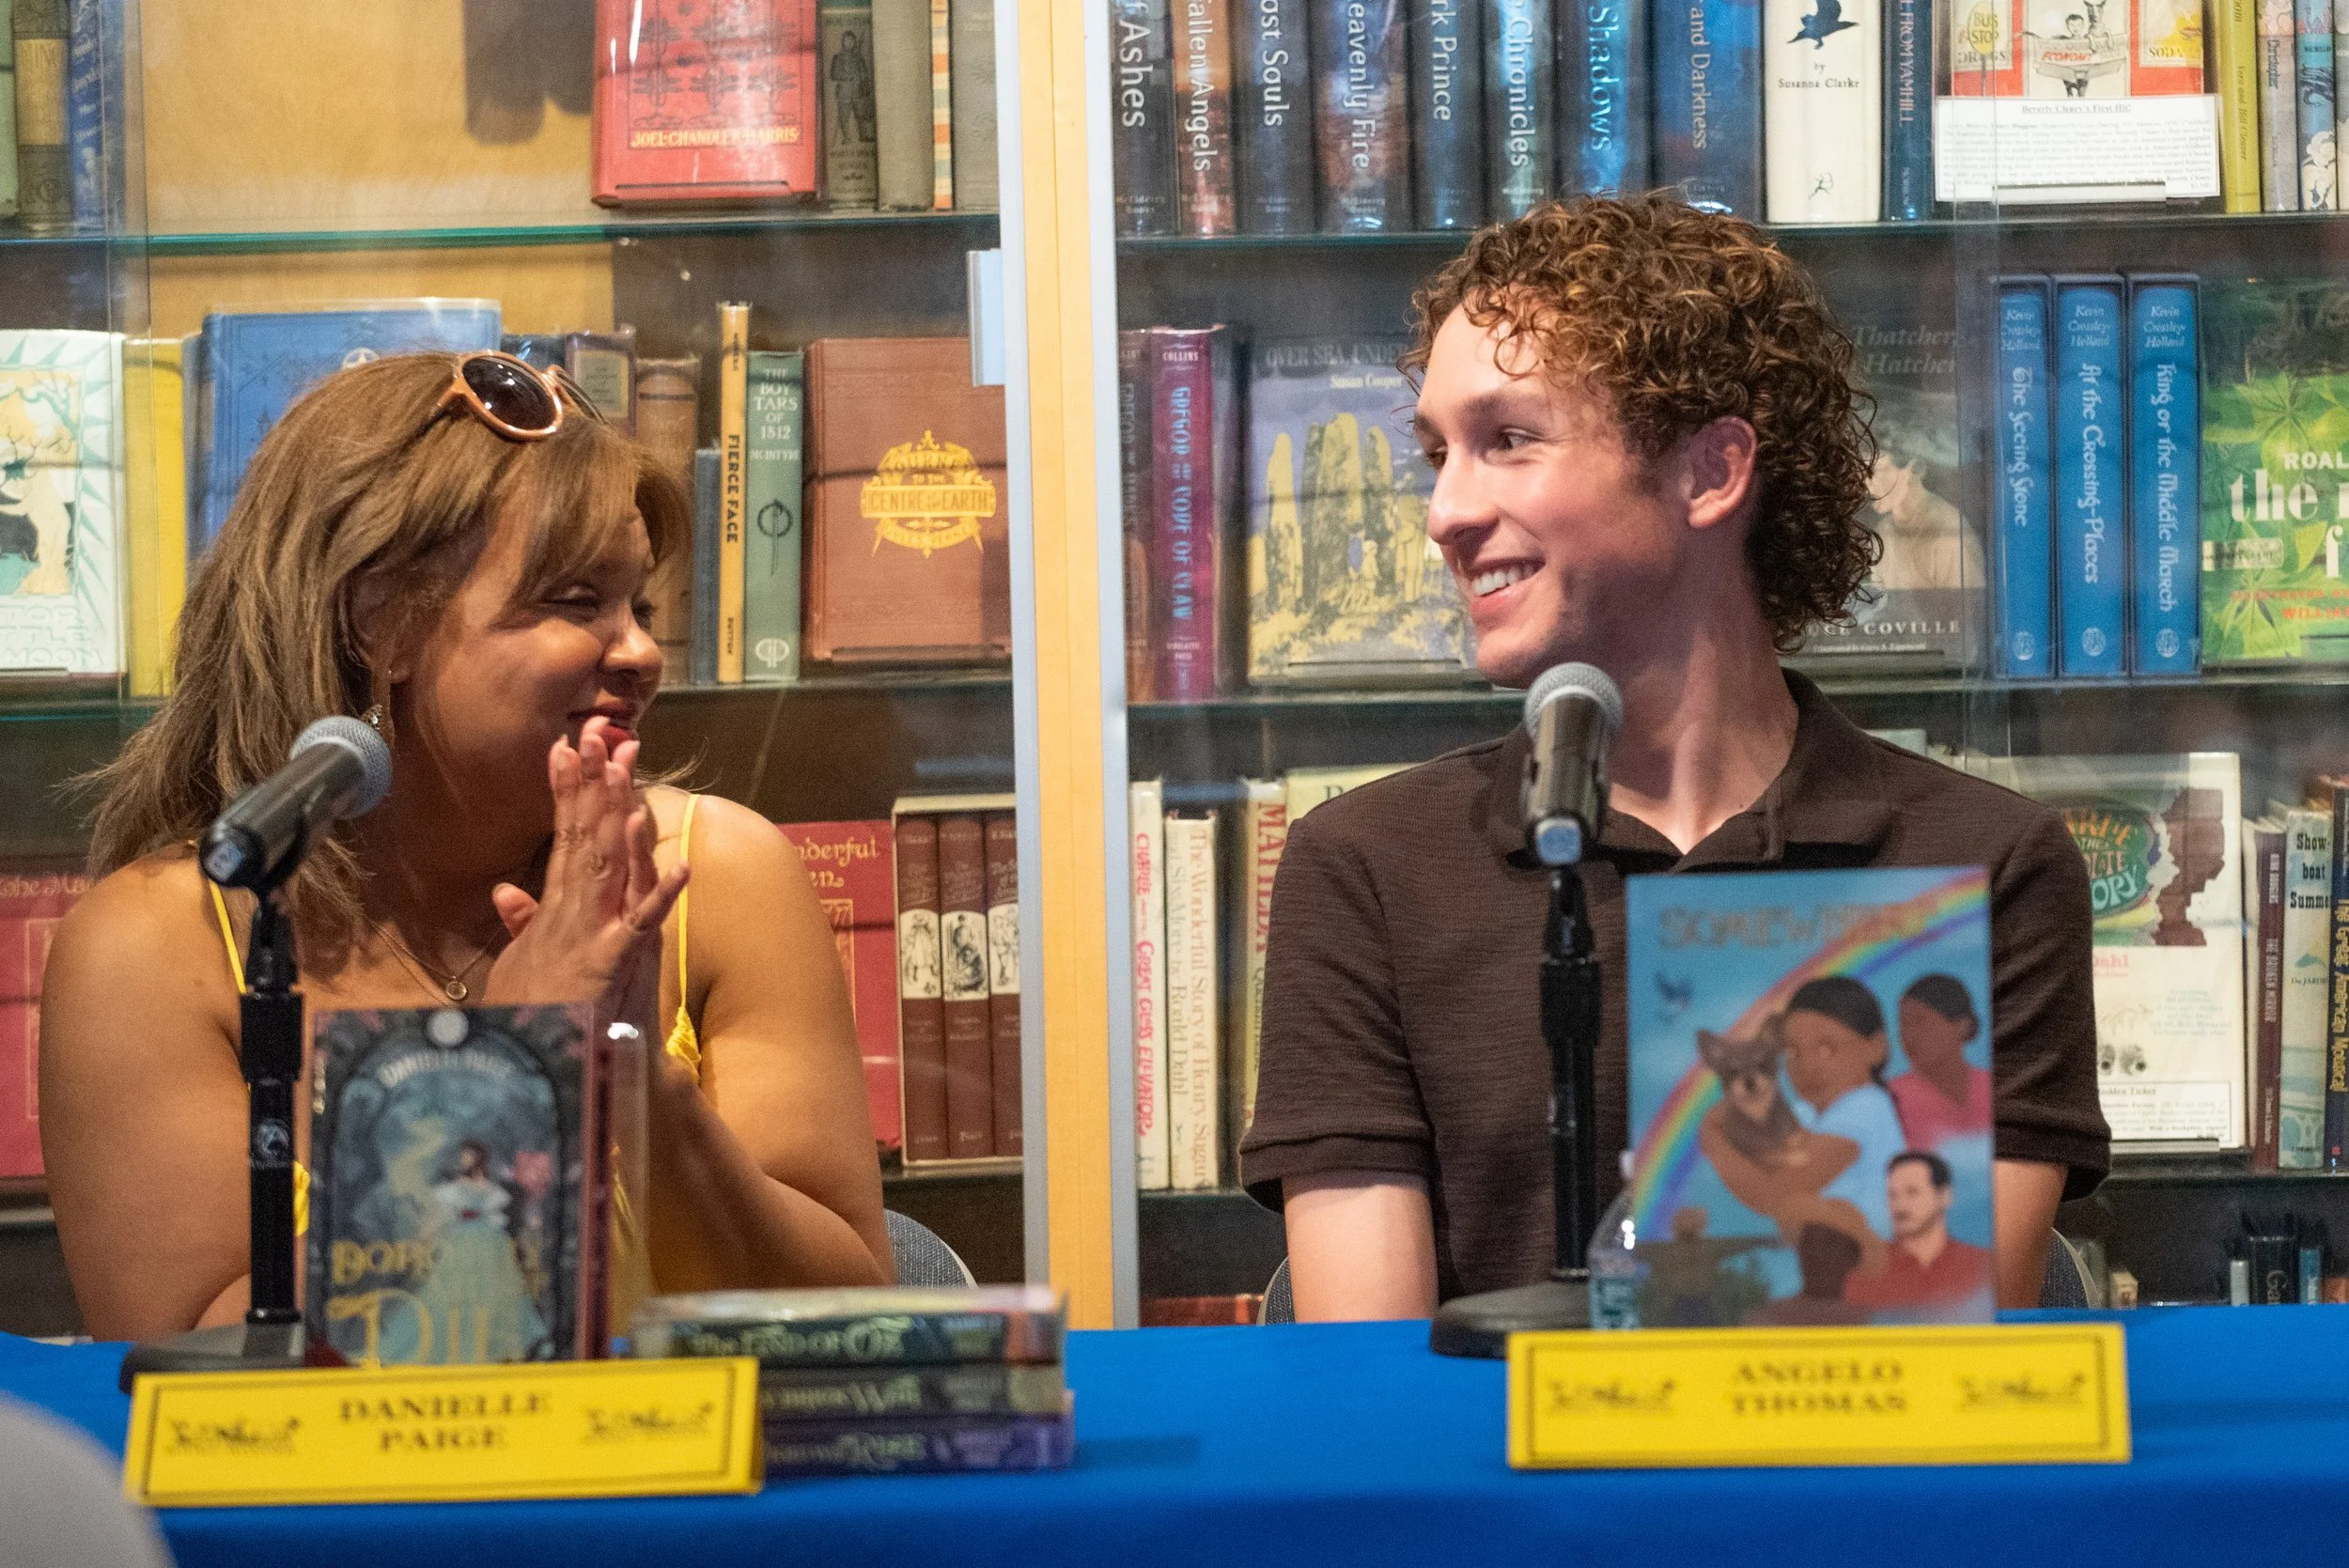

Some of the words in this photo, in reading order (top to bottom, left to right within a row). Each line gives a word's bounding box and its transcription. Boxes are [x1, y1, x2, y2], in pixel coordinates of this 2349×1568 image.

[1260, 0, 1281, 40] ost
[1691, 7, 1709, 46] and
[1899, 12, 1915, 57] FROM
[1972, 28, 1999, 44] STOP
[1974, 12, 1999, 26] BUS
[1188, 0, 1213, 75] allen
[1119, 19, 1153, 127] Ashes
[1344, 0, 1374, 112] eavenly
[1814, 62, 1825, 74] by
[1958, 51, 2007, 63] DRGS
[1262, 50, 1290, 127] Souls
[1432, 37, 1456, 121] Prince
[1507, 16, 1536, 166] Chronicles
[1588, 6, 1620, 150] Shadows
[1778, 77, 1819, 89] Susanna
[1826, 77, 1859, 89] Clarke
[1899, 59, 1915, 127] YAMHILL
[1690, 53, 1711, 149] Darkness
[1185, 79, 1218, 172] Angels
[1352, 118, 1377, 168] Fire
[2075, 304, 2105, 317] Kevin
[2150, 305, 2180, 318] Kevin
[1161, 350, 1200, 362] COLLINS
[1352, 342, 1408, 365] UNDE
[759, 382, 790, 396] BOY
[2011, 367, 2033, 406] The
[2081, 363, 2101, 388] At
[2150, 363, 2177, 405] King
[754, 396, 799, 411] TARS
[765, 411, 786, 424] OF
[2082, 388, 2102, 420] the
[760, 425, 792, 441] 1812
[1171, 386, 1191, 456] GREGOR
[2009, 411, 2034, 476] Seeing
[2157, 436, 2178, 468] the
[727, 434, 740, 494] FIERCE
[2283, 451, 2349, 471] ROAL
[870, 489, 923, 511] CENTRE
[941, 489, 989, 510] EARTH
[2157, 473, 2180, 541] Middle
[2230, 468, 2319, 523] the
[726, 500, 739, 544] FACE
[1173, 540, 1192, 565] OF
[2158, 544, 2180, 613] March
[1862, 619, 1961, 636] COVILLE
[792, 834, 879, 868] nderful
[1190, 830, 1208, 862] The
[2302, 862, 2326, 880] boat
[2290, 892, 2332, 909] Summe
[1190, 872, 1209, 970] Wonderful
[1172, 986, 1190, 1042] Roald
[1188, 973, 1206, 1027] Story
[1191, 1032, 1207, 1050] of
[1173, 1048, 1190, 1095] Dahl
[1189, 1057, 1210, 1116] Henry
[1734, 1360, 1905, 1387] ANGELO
[339, 1392, 553, 1425] DANIELLE
[1732, 1390, 1908, 1416] THOMAS
[381, 1426, 507, 1452] PAIGE
